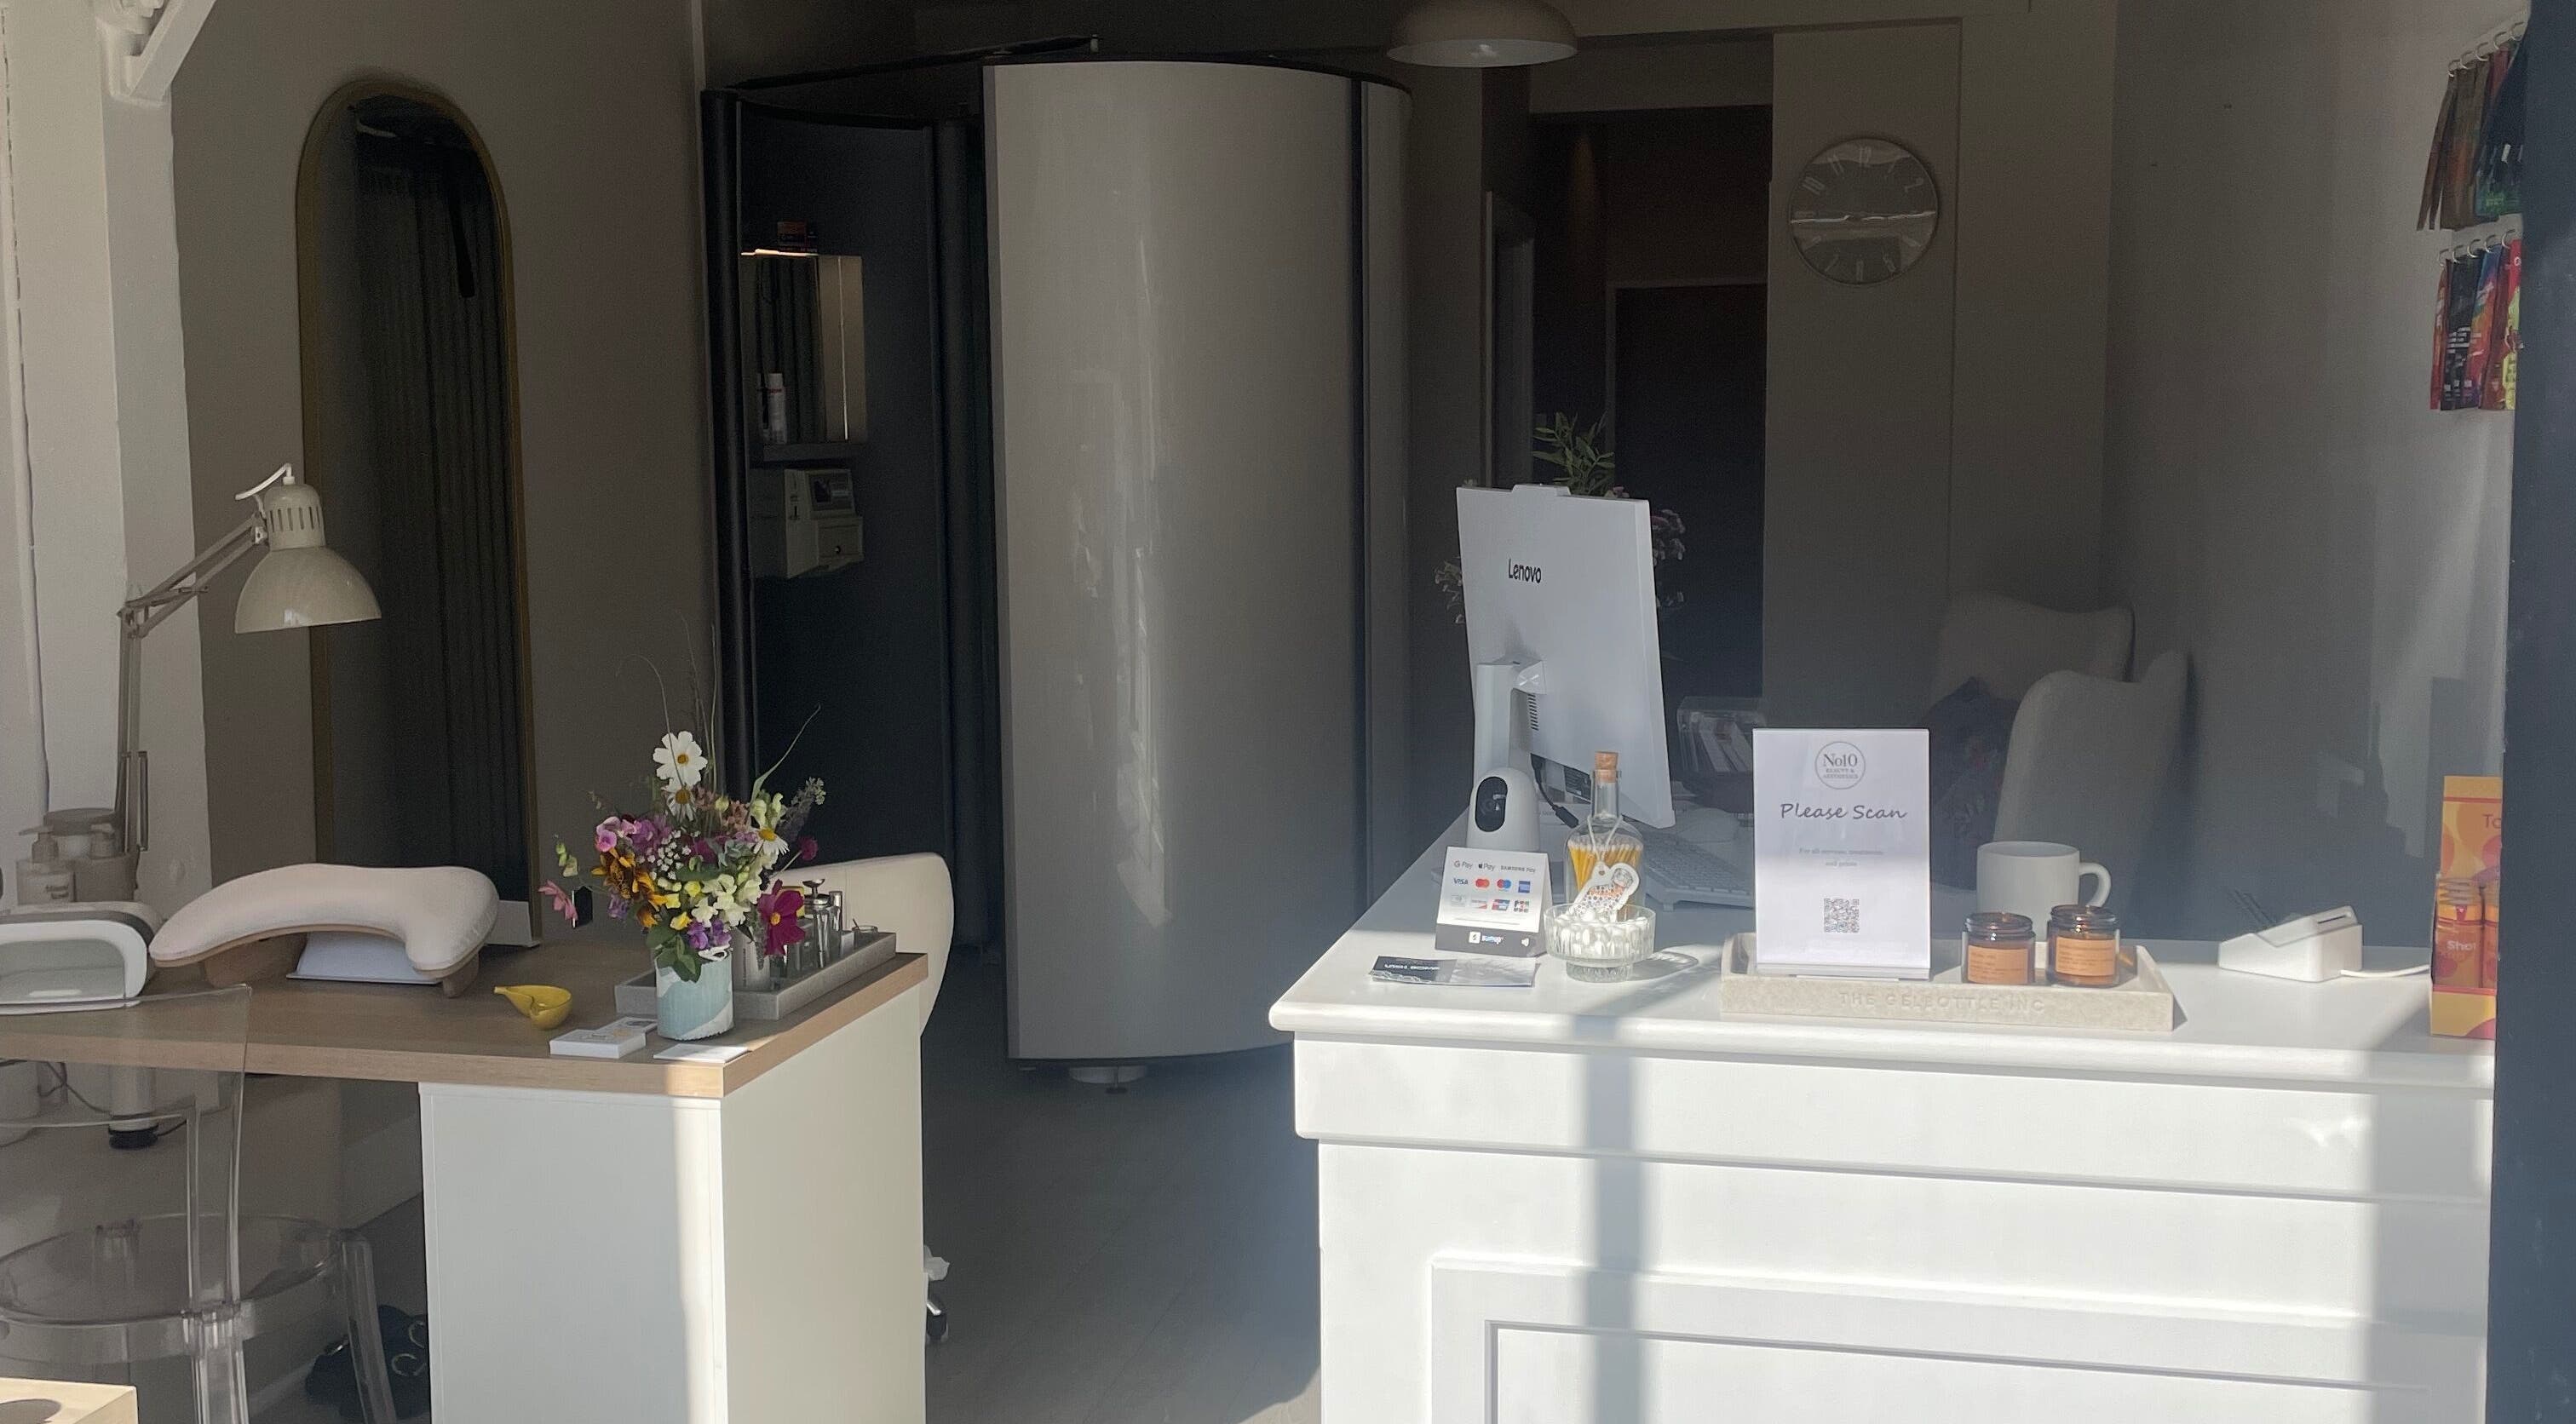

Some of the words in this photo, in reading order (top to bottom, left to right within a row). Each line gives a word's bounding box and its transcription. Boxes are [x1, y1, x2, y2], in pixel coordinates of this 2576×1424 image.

[1508, 558, 1542, 583] Lenovo
[1823, 753, 1858, 767] No10
[1780, 802, 1848, 820] Please
[1853, 805, 1908, 820] Scan
[1462, 861, 1474, 870] Pay
[1483, 863, 1496, 871] Pay
[1839, 992, 1876, 1006] THE
